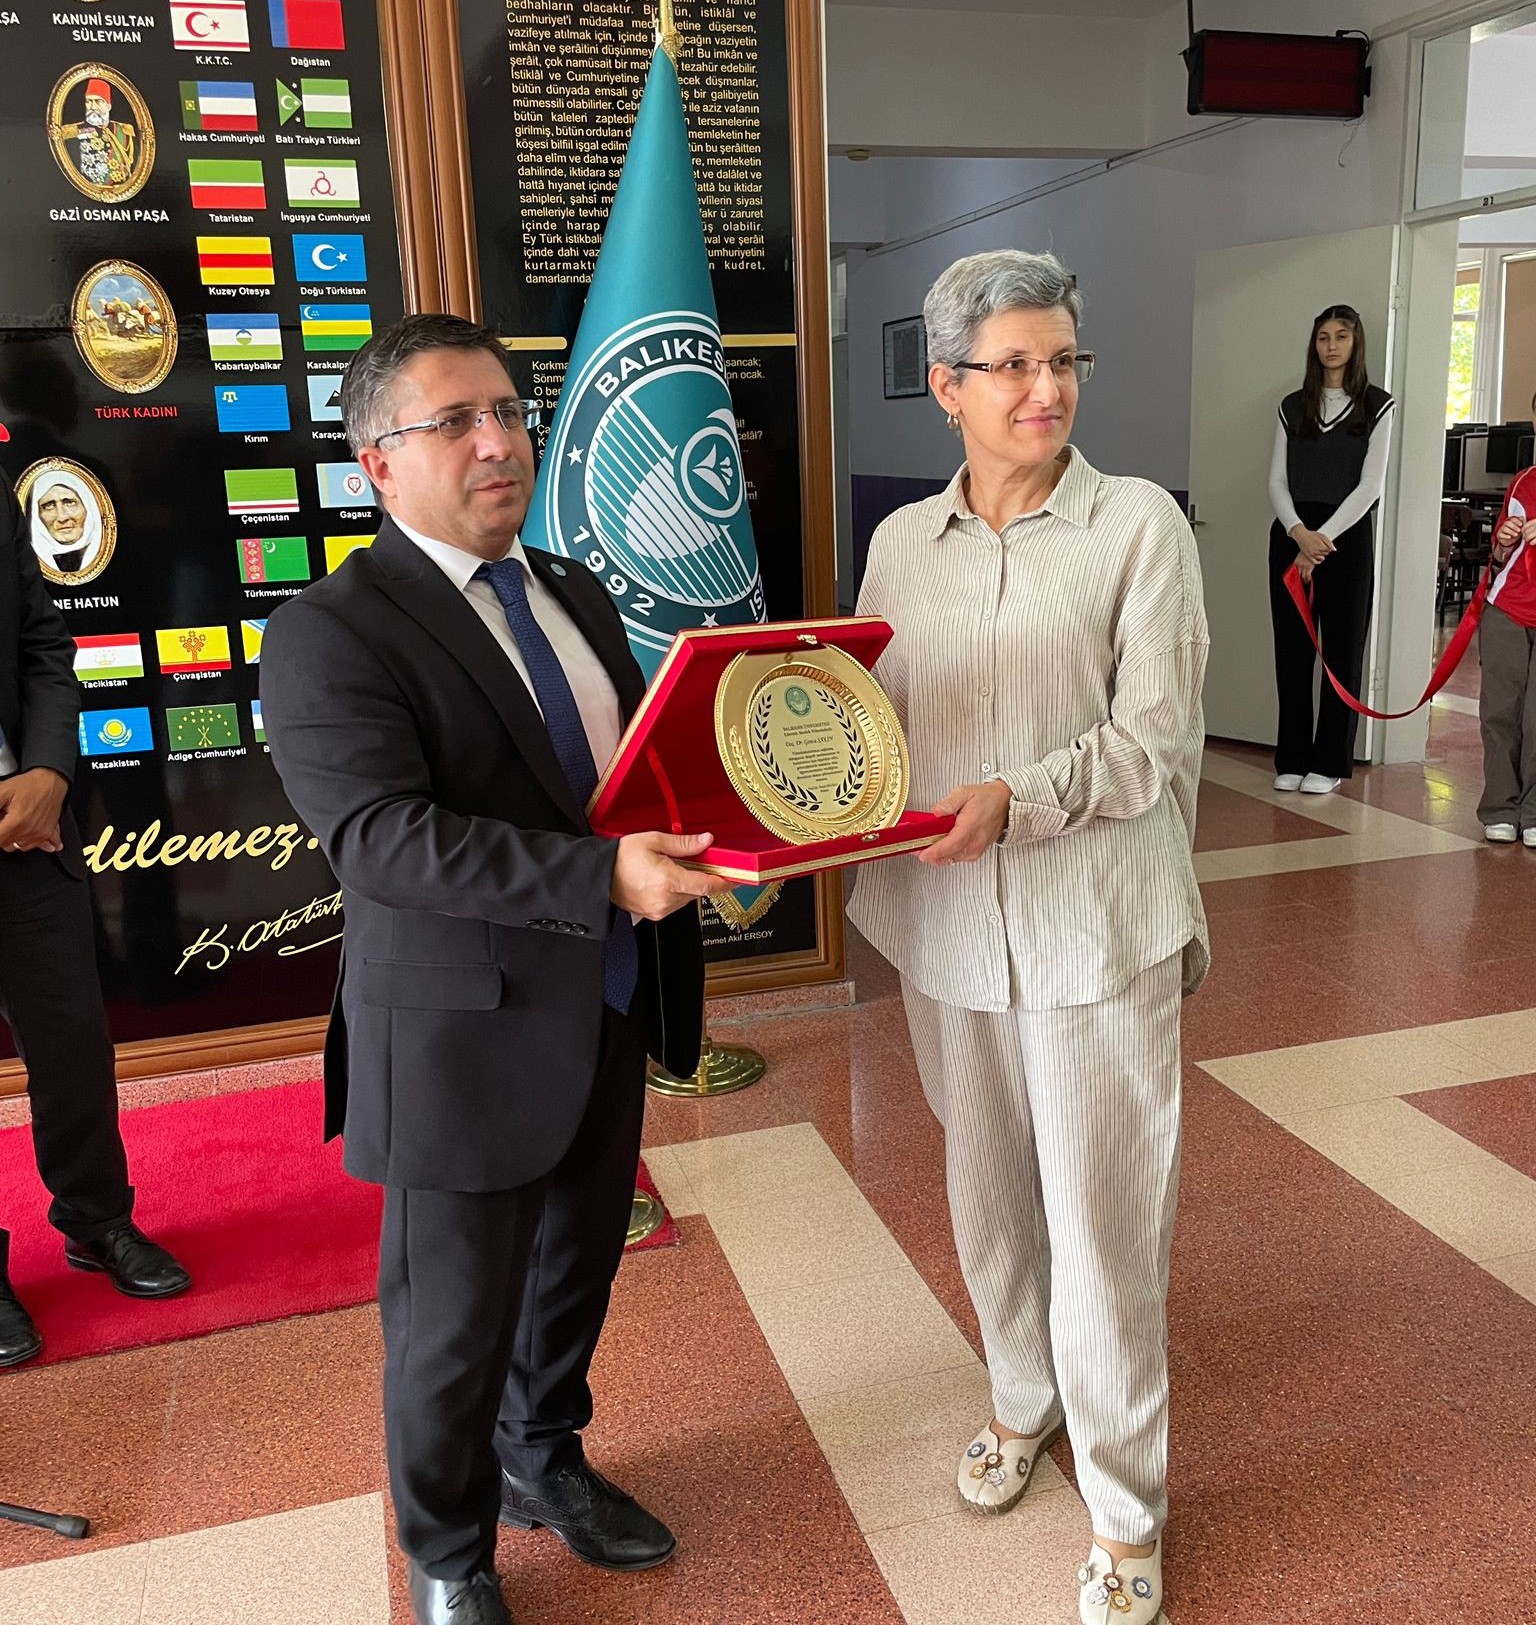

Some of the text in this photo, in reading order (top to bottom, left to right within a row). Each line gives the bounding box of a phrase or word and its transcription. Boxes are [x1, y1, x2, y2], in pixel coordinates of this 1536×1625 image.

[506, 0, 573, 11] bedhahların
[583, 2, 634, 14] olacaktır.
[674, 7, 691, 17] ün,
[701, 7, 735, 18] istiklâl
[744, 10, 756, 19] ve
[0, 12, 20, 26] ŞA
[52, 12, 154, 27] KANUNİ SULTAN
[580, 16, 624, 28] müdafaa
[709, 21, 756, 34] düşersen,
[72, 28, 142, 42] SÜLEYMAN
[508, 28, 551, 40] vazifeye
[554, 30, 591, 40] atılmak
[594, 30, 615, 43] için,
[618, 31, 648, 44] içinde
[715, 37, 757, 48] vaziyetin
[509, 40, 540, 52] imkân
[559, 44, 598, 55] şerâitini
[697, 49, 711, 58] Bu
[714, 50, 743, 60] imkân
[746, 52, 757, 60] ve
[195, 56, 233, 66] K.K.T.C.
[291, 56, 331, 67] Dağıstan
[510, 56, 541, 67] şerâit,
[544, 57, 563, 68] çok
[566, 58, 612, 69] namüsait
[614, 59, 627, 69] bir
[681, 62, 718, 72] tezahür
[721, 63, 758, 74] edebilir.
[549, 72, 561, 80] ve
[566, 71, 639, 84] Cumhuriyetine
[705, 76, 758, 88] düşmanlar,
[512, 83, 541, 94] bütün
[546, 84, 590, 97] dünyada
[595, 87, 627, 96] emsali
[694, 89, 706, 99] bir
[711, 90, 759, 102] galibiyetin
[513, 97, 564, 108] mümessili
[566, 99, 614, 110] olabilirler.
[689, 103, 700, 112] ile
[703, 103, 721, 112] aziz
[724, 104, 759, 113] vatanın
[514, 111, 543, 121] bütün
[551, 112, 588, 122] kaleleri
[698, 117, 760, 127] tersanelerine
[179, 132, 266, 145] Hakas Cumhuriyeti
[515, 125, 554, 137] girilmiş,
[555, 126, 584, 136] bütün
[586, 127, 624, 137] orduları
[688, 130, 743, 140] memleketin
[745, 131, 760, 140] her
[275, 134, 361, 146] Batı Trakya Türkleri
[516, 139, 549, 151] köşesi
[551, 140, 573, 150] bilfiil
[575, 141, 599, 152] işgal
[601, 141, 628, 151] edilm
[705, 143, 717, 153] bu
[720, 144, 761, 154] şerâitten
[517, 153, 542, 163] daha
[569, 155, 581, 163] ve
[583, 154, 608, 163] daha
[707, 157, 761, 166] memleketin
[518, 166, 567, 178] dahilinde,
[569, 167, 605, 177] iktidara
[703, 171, 714, 179] ve
[716, 170, 748, 179] dalâlet
[519, 180, 763, 192] hattâ hıyanet içinde attâ bu iktidar
[520, 194, 565, 205] sahipleri,
[736, 196, 763, 207] siyasi
[50, 207, 169, 223] GAZİ OSMAN PAŞA
[209, 213, 254, 223] Tataristan
[281, 212, 371, 223] İnguşya Cumhuriyeti
[521, 207, 575, 219] emelleriyle
[579, 208, 608, 217] tevhid
[721, 209, 726, 218] ü
[731, 210, 763, 219] zaruret
[522, 221, 557, 232] içinde
[567, 221, 600, 232] harap
[723, 222, 763, 231] olabilir.
[523, 234, 536, 245] Ey
[539, 234, 562, 244] Türk
[724, 236, 735, 244] ve
[738, 235, 764, 246] şerâit
[524, 247, 553, 259] içinde
[558, 247, 579, 257] dahi
[706, 248, 764, 259] umhuriyetini
[724, 261, 765, 270] kudret,
[526, 274, 593, 283] damarlarında
[209, 287, 237, 297] Kuzey
[300, 286, 367, 296] Doğu Türkistan
[214, 361, 282, 372] Kabartaybalkar
[726, 358, 761, 367] sancak;
[740, 370, 765, 379] ocak.
[534, 387, 542, 396] O
[95, 406, 178, 419] TÜRK KADINI
[244, 434, 269, 444] Kırım
[241, 513, 290, 524] Çeçenistan
[339, 510, 372, 520] Gagauz
[572, 525, 656, 616] 1992
[74, 596, 119, 609] HATUN
[173, 670, 222, 682] Çuvaşistan
[82, 678, 128, 689] Tacikistan
[167, 746, 248, 761] Adige Cumhuriyeti
[91, 758, 141, 770] Kazakistan
[703, 930, 773, 946] ehmet Akif ERSOY
